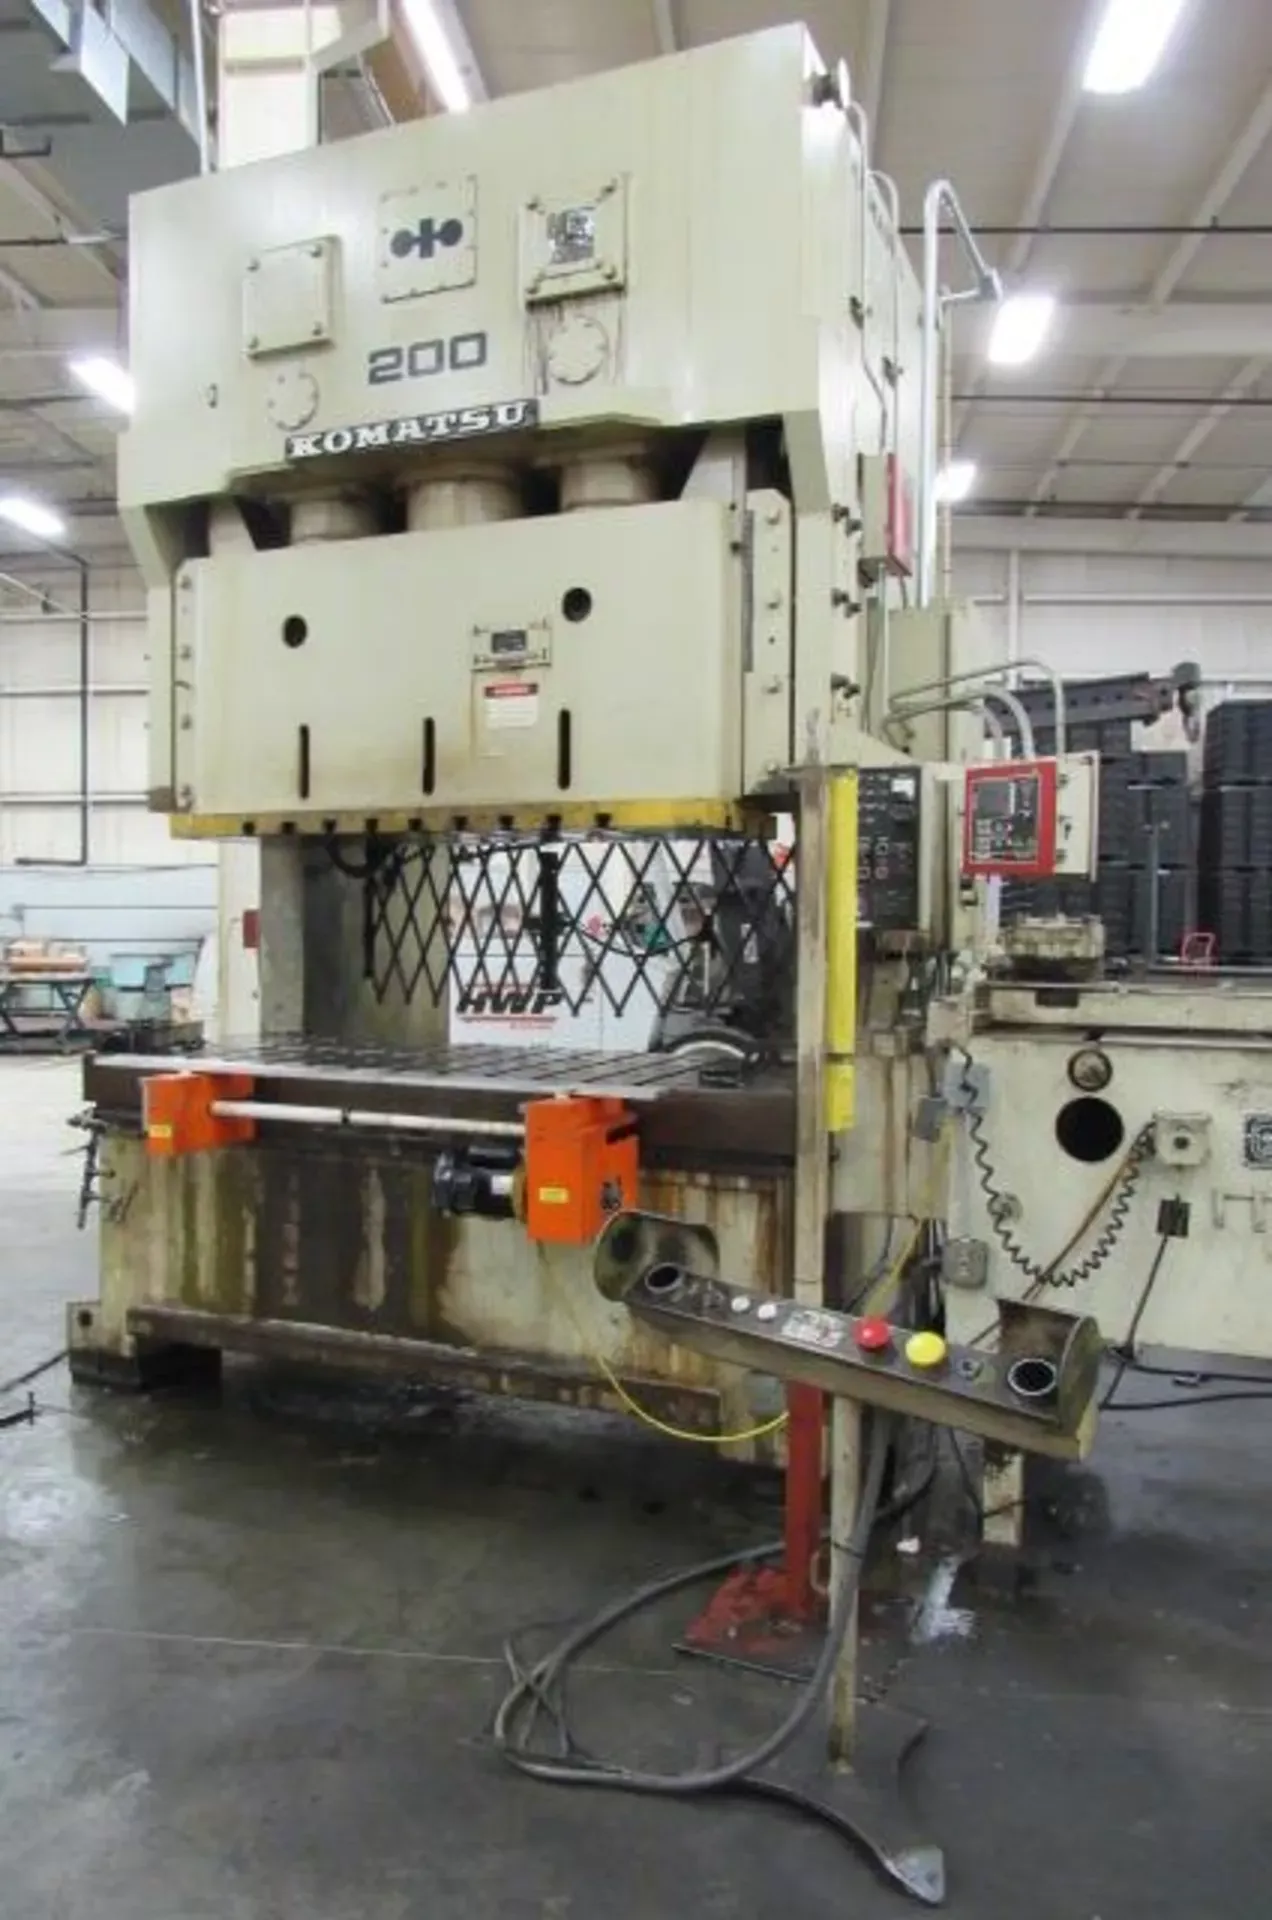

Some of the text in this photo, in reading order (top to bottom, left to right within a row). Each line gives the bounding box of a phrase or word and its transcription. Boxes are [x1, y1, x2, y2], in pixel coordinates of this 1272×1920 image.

[367, 331, 488, 385] 200
[288, 401, 528, 459] KOMATSU
[456, 990, 563, 1015] HWP
